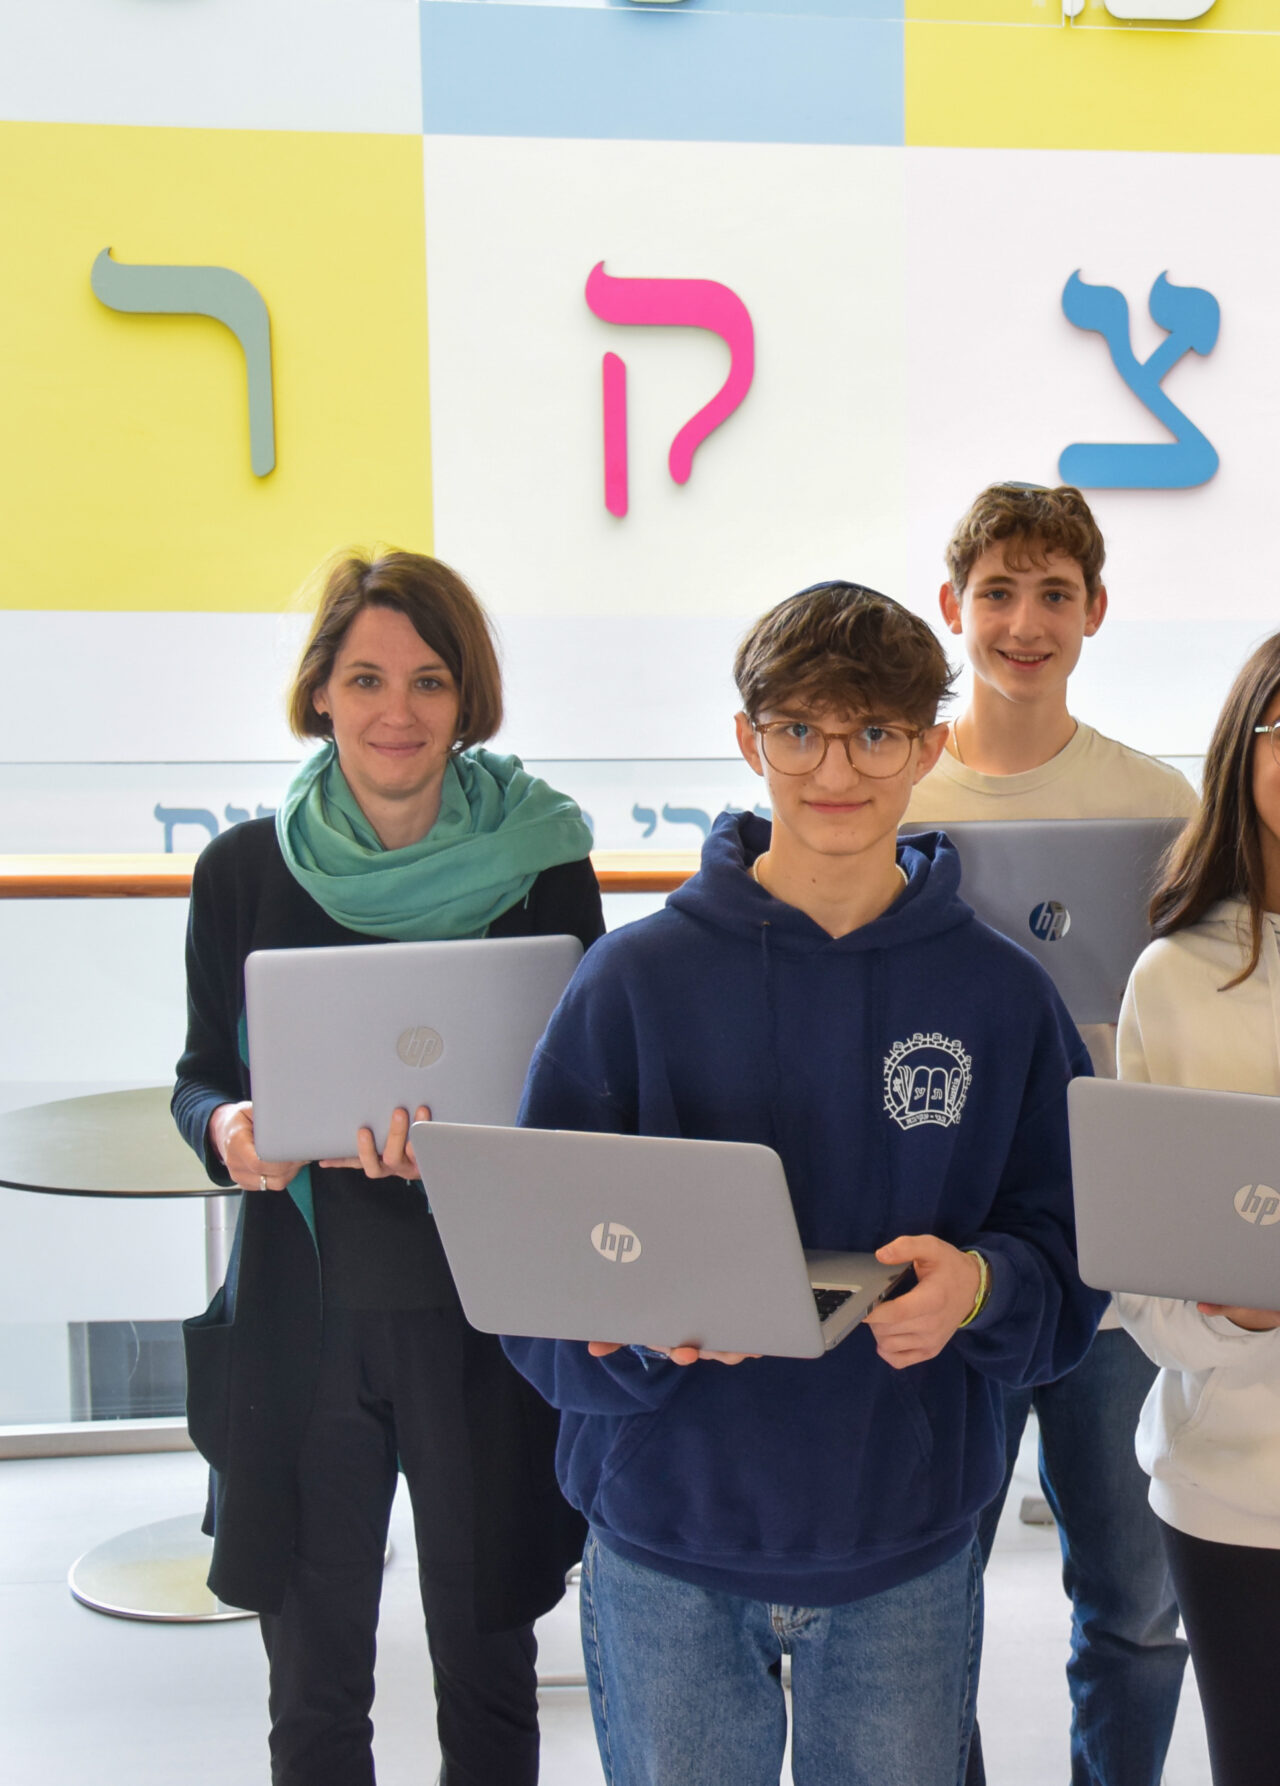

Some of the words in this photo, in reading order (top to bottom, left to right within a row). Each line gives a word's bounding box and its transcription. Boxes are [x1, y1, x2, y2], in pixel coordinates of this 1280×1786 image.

[91, 246, 276, 478] ר
[1058, 269, 1221, 489] צ
[585, 260, 755, 518] ק
[1035, 901, 1066, 941] hp
[404, 1027, 439, 1068] hp
[1240, 1184, 1280, 1225] hp
[599, 1221, 635, 1263] hp
